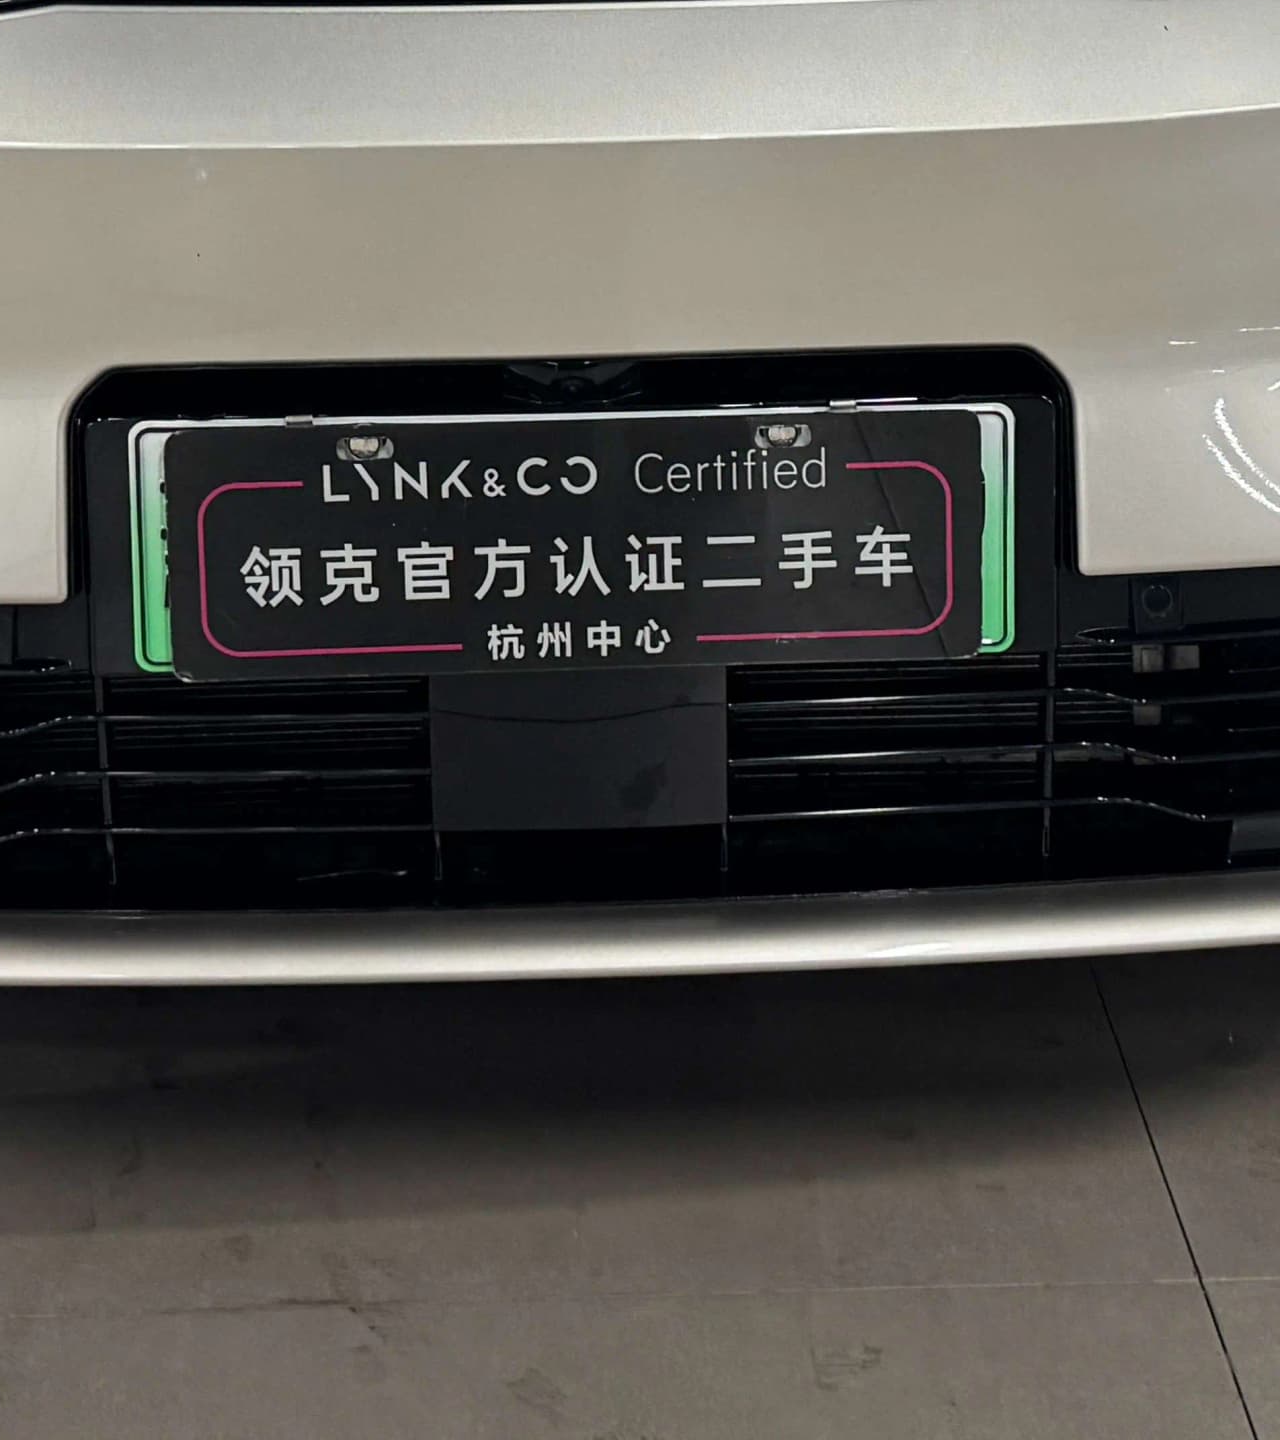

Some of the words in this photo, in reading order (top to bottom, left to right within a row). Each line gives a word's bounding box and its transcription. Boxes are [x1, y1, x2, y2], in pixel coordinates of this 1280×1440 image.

[633, 448, 828, 492] Certified
[239, 526, 915, 609] 领克官方认证二手车
[487, 618, 671, 662] 杭州中心
